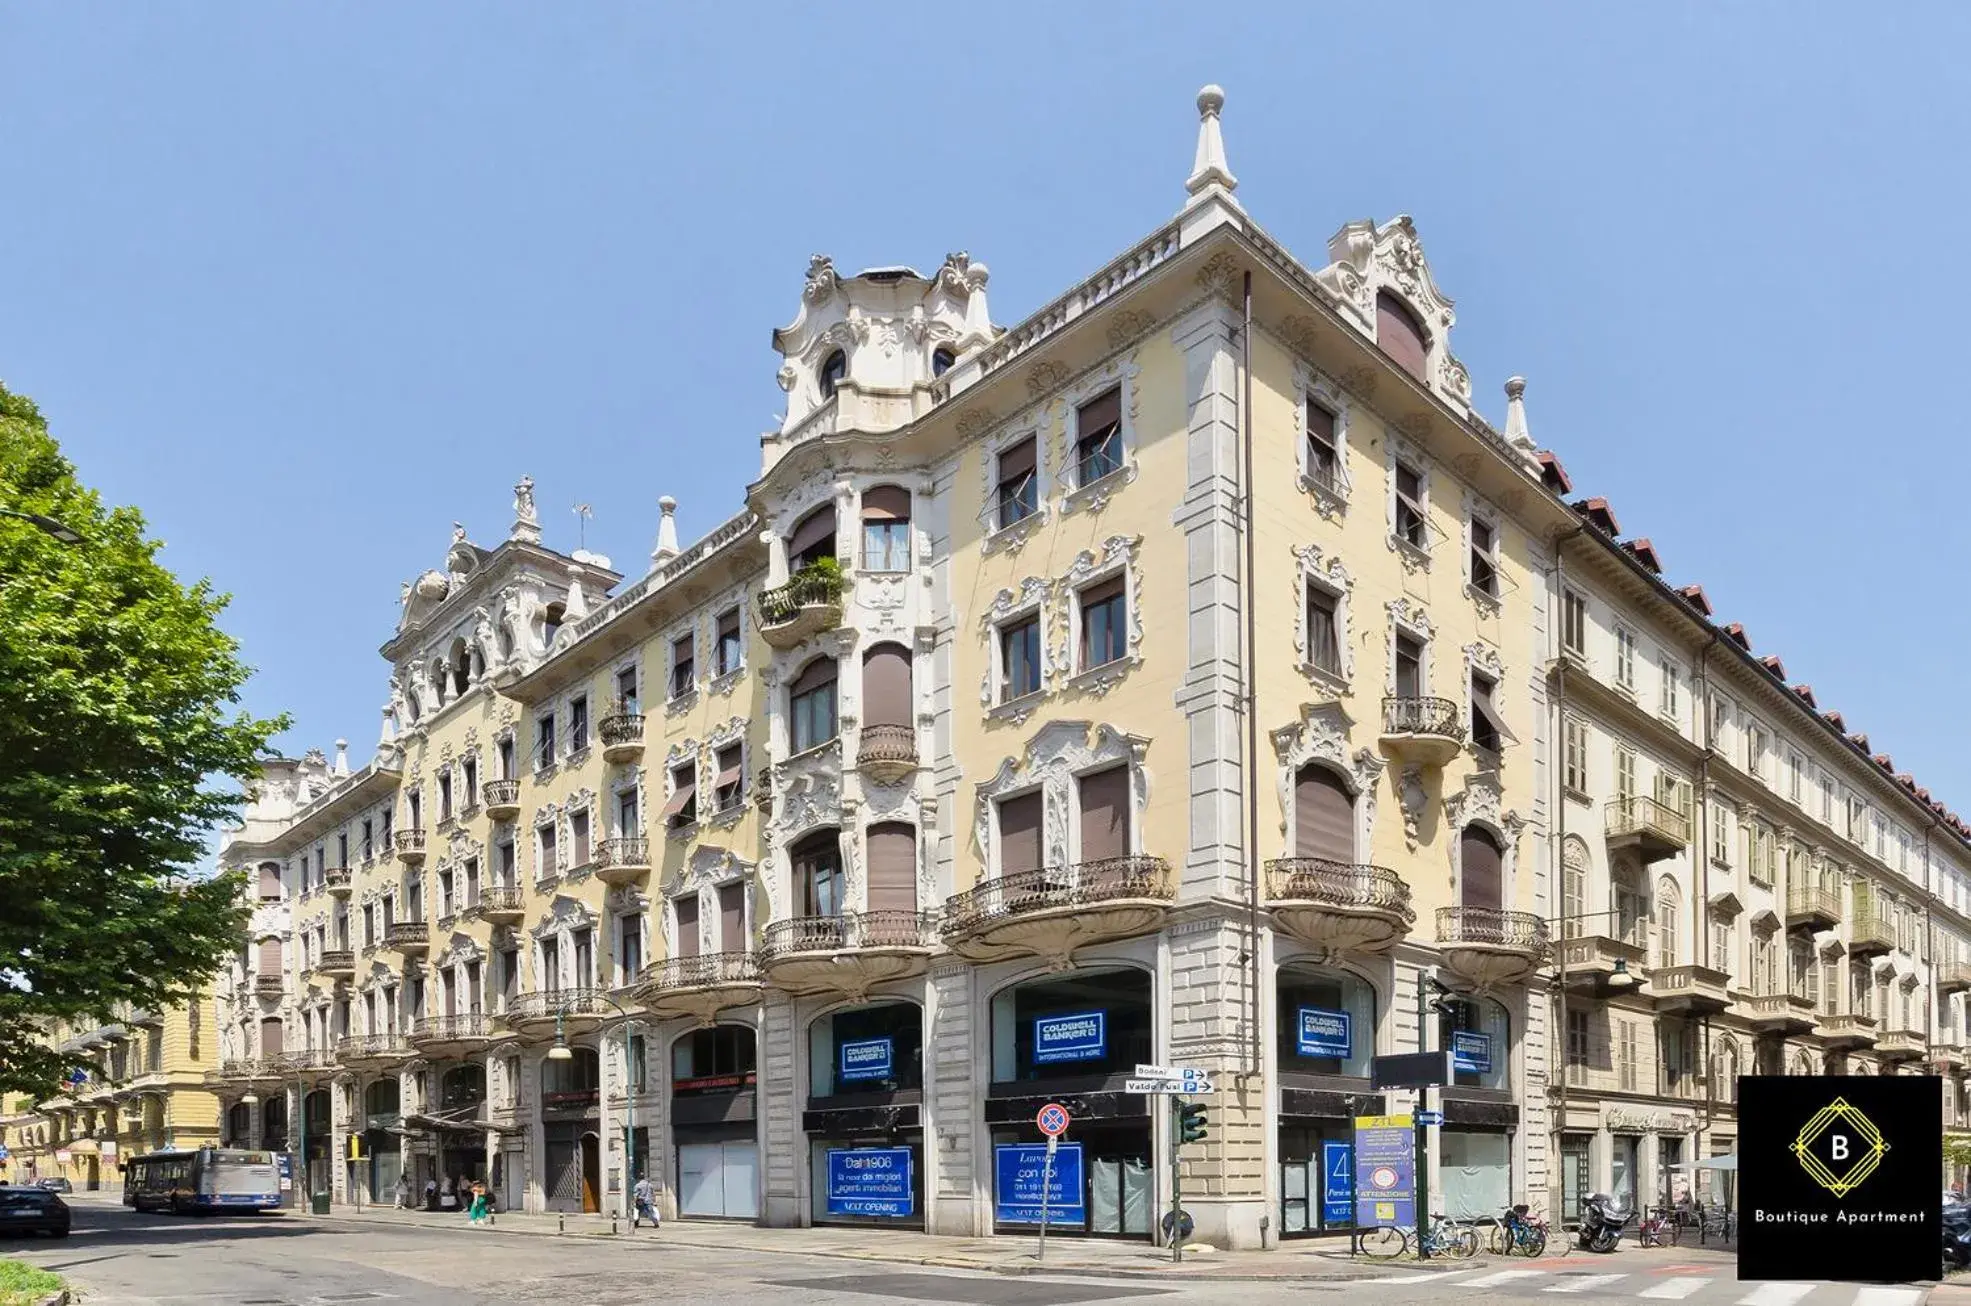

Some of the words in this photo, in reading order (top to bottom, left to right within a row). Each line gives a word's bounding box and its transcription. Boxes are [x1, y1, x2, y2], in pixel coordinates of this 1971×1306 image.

[1043, 1020, 1096, 1034] COLDWELL
[1305, 1016, 1345, 1029] COLDWELL
[1043, 1030, 1087, 1041] BANKER
[1128, 1082, 1157, 1090] Valdo
[866, 1156, 892, 1169] 1906
[1018, 1169, 1038, 1178] con
